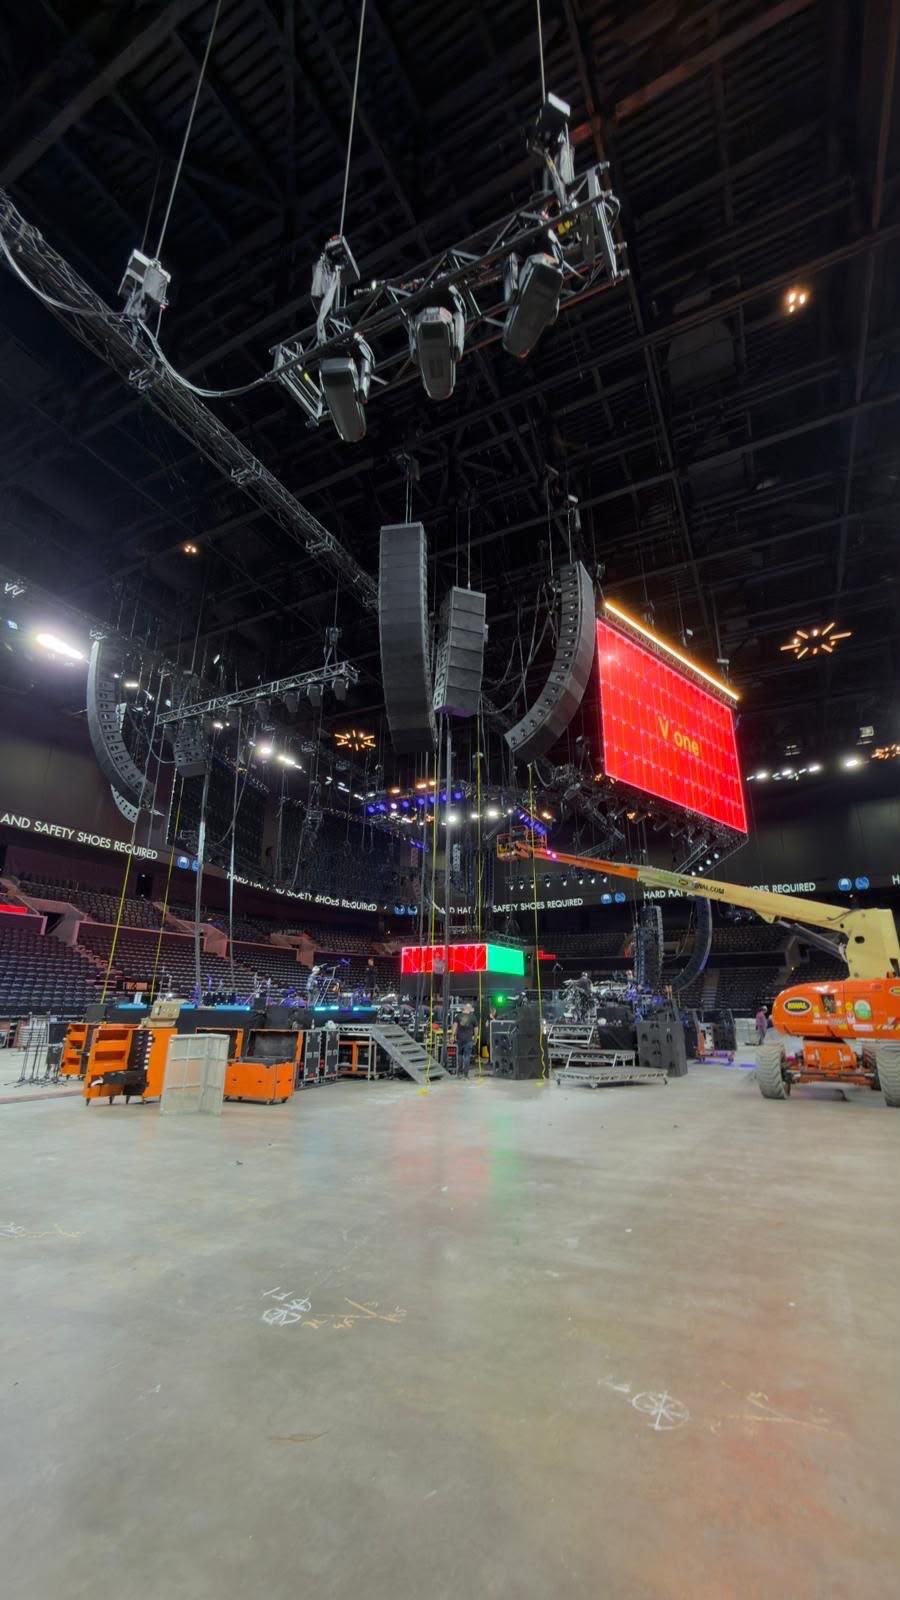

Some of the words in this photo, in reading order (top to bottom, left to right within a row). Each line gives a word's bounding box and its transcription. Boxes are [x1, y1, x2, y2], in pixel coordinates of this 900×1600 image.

[673, 731, 699, 757] one
[0, 813, 31, 828] AND
[34, 821, 75, 839] SAFETY
[77, 832, 112, 849] SHOES
[114, 841, 158, 860] REQUIRED
[643, 890, 666, 899] HARD
[772, 882, 816, 893] REQUIRED
[314, 895, 340, 907] SHOES
[341, 899, 377, 912] REQUIRED
[492, 902, 519, 913] SAFETY
[520, 900, 546, 911] SHOES
[547, 898, 583, 909] REQUIRED
